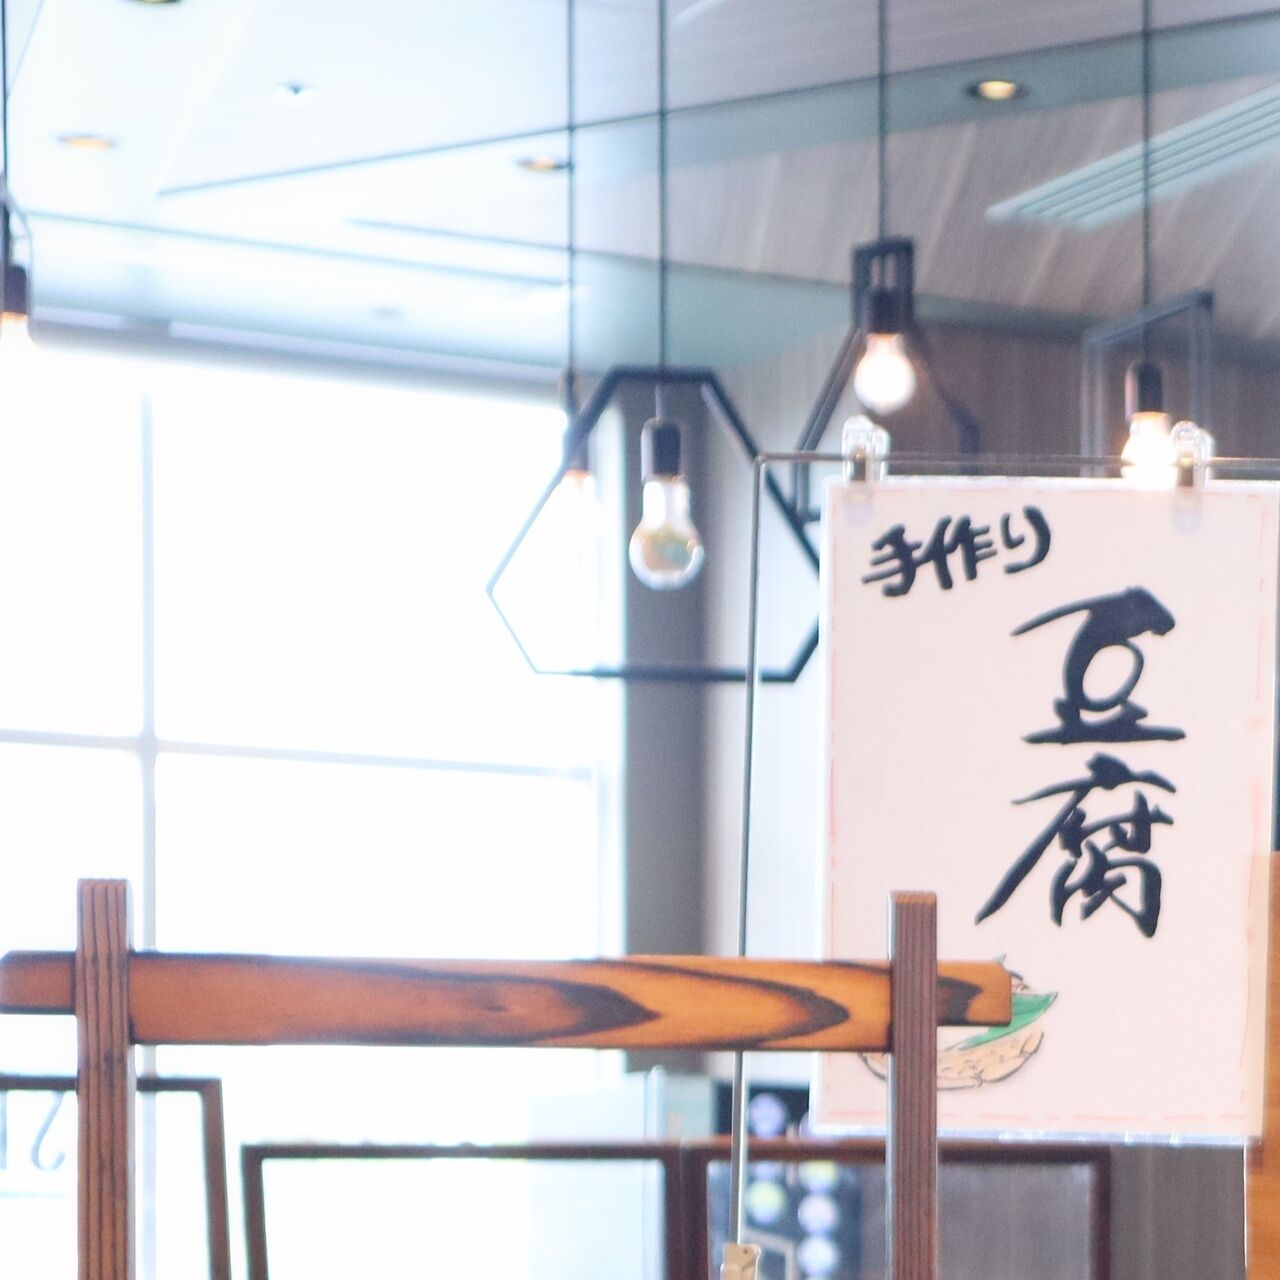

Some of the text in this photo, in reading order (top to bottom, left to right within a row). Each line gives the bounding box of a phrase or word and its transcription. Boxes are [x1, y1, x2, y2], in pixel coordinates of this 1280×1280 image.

[861, 505, 1051, 597] 手作り
[975, 586, 1187, 938] 豆腐
